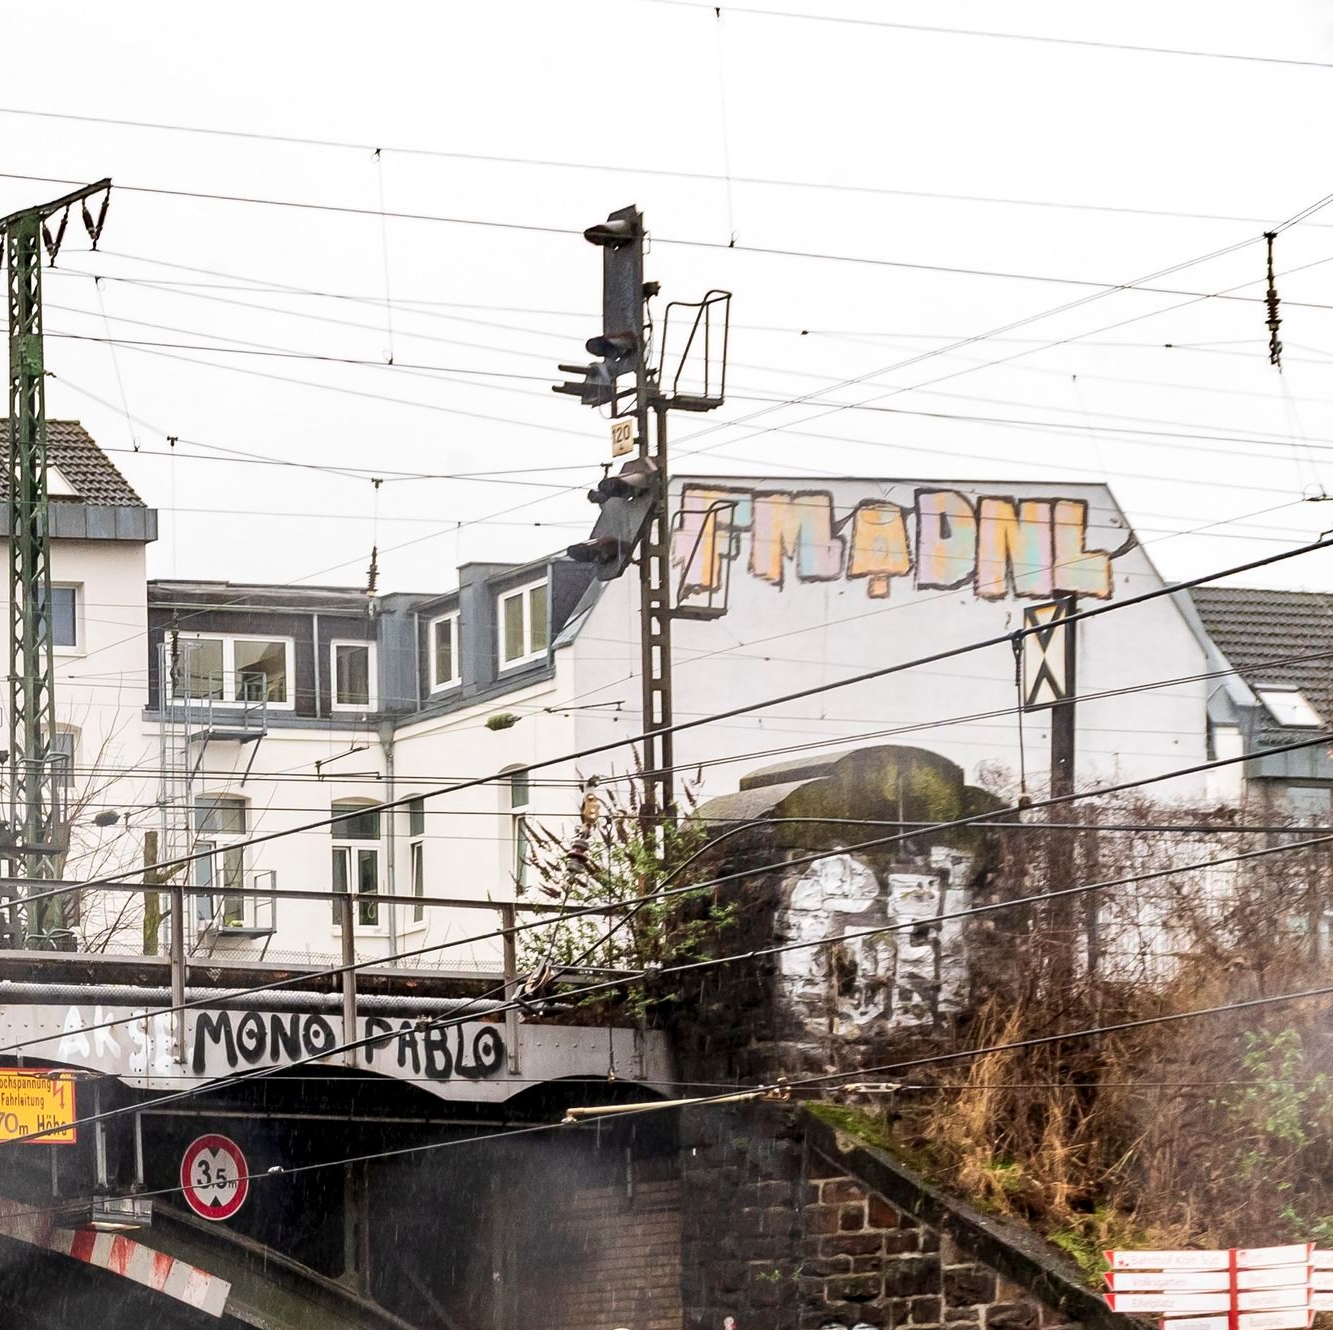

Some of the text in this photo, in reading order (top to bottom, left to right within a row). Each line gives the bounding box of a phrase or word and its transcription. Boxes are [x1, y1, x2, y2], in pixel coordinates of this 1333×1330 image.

[192, 1010, 505, 1082] MONO PABLO
[1, 1092, 44, 1109] Fahrleitung
